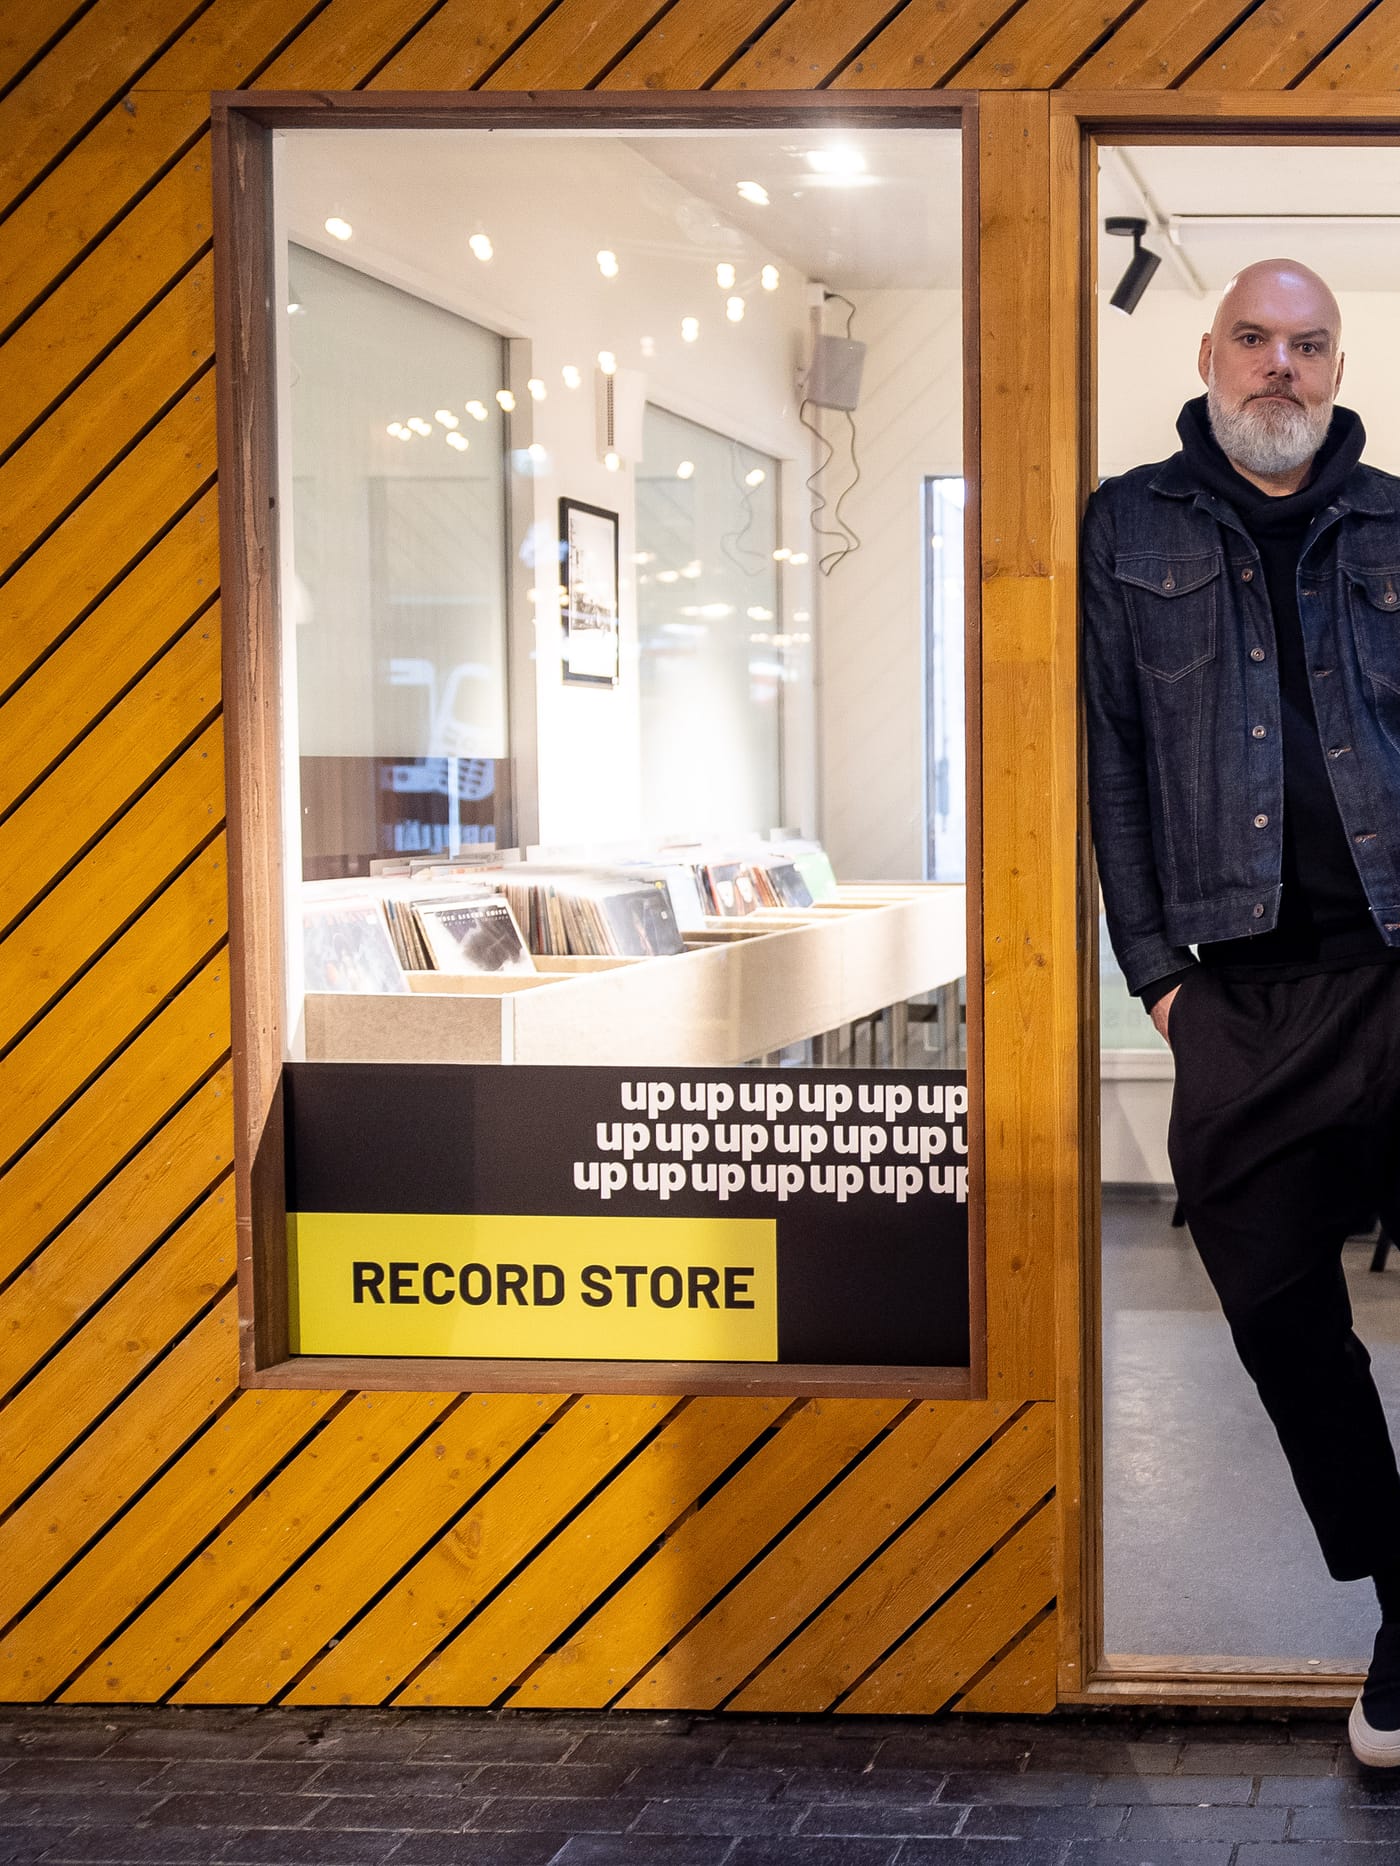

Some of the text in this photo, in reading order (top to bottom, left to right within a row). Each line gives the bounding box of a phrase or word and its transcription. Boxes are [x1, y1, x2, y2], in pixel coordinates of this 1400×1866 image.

[620, 1081, 968, 1123] up up up up up up
[596, 1122, 651, 1161] up
[655, 1123, 710, 1161] up
[714, 1123, 769, 1162] up
[773, 1124, 828, 1163] up
[833, 1125, 888, 1163] up
[892, 1125, 947, 1164] up
[573, 1161, 628, 1200] up
[632, 1162, 687, 1201] up
[691, 1163, 746, 1201] up
[750, 1164, 805, 1202] up
[810, 1164, 864, 1203] up
[869, 1165, 924, 1203] up
[352, 1260, 755, 1310] RECORD STORE
